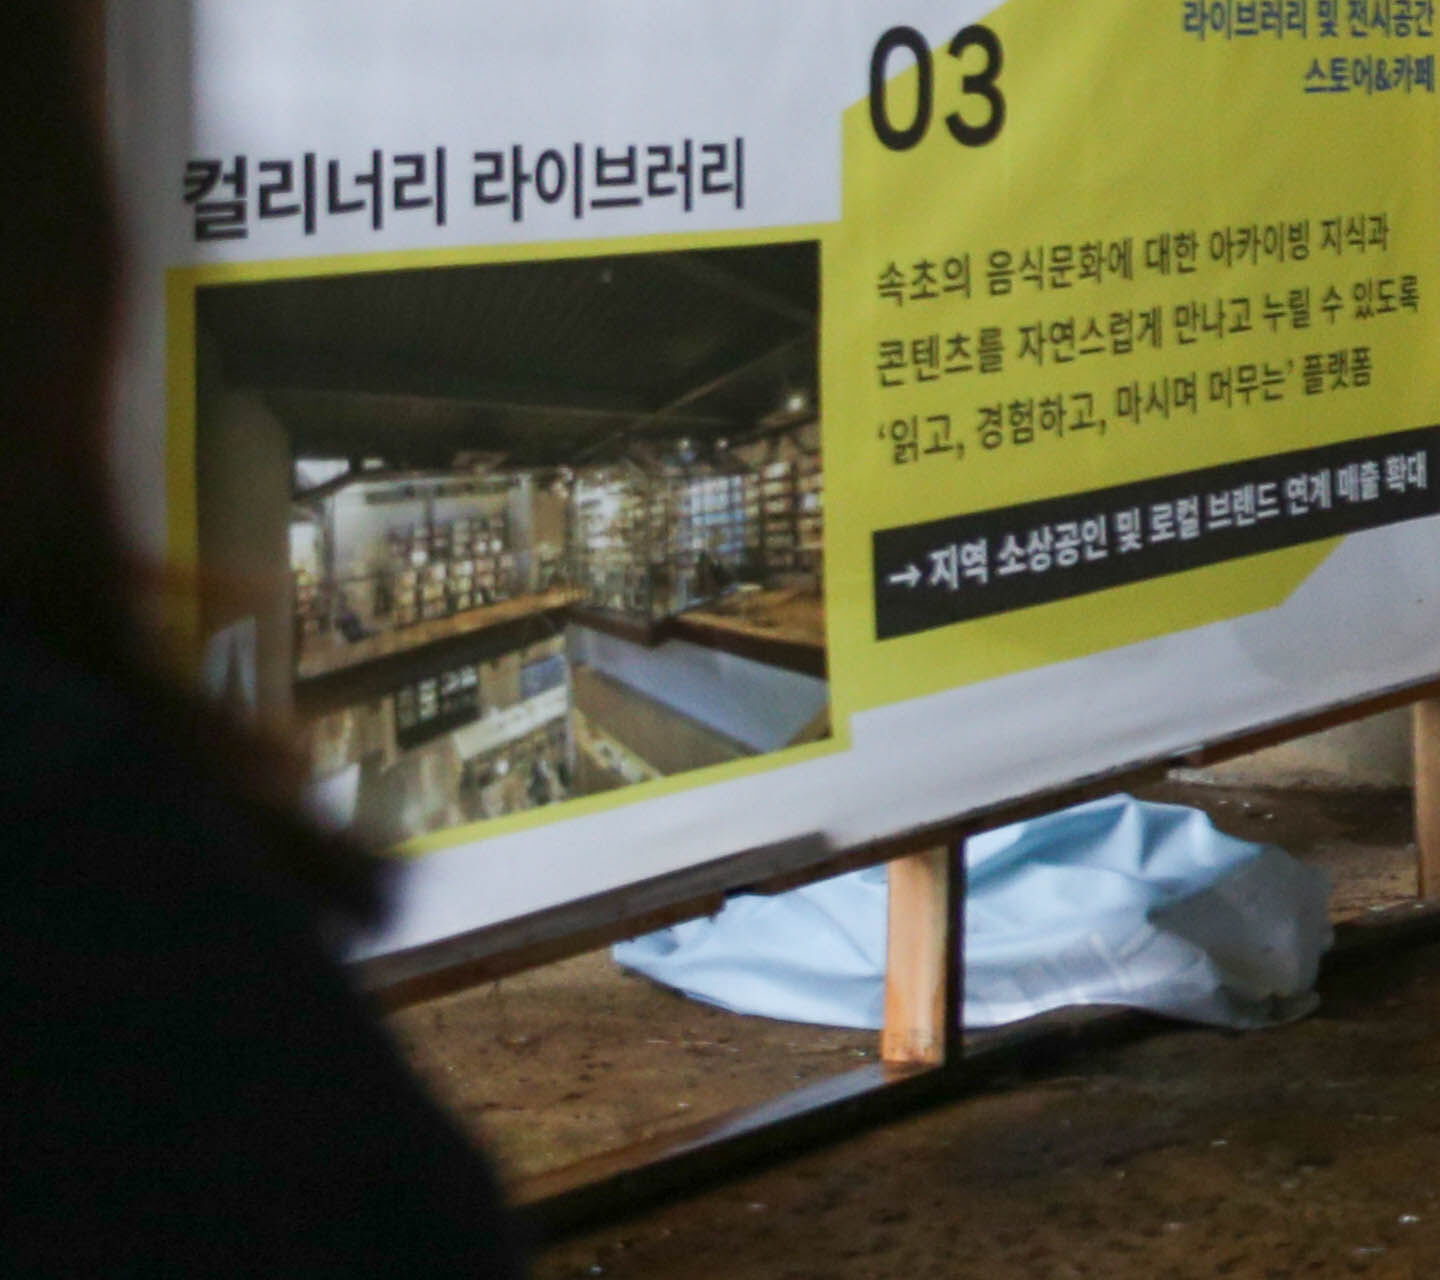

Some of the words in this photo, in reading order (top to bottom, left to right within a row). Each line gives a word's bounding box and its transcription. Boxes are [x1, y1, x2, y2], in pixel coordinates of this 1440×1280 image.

[868, 24, 1007, 151] 03
[1303, 54, 1435, 96] 스토어&카페
[183, 145, 446, 242] 컬리너리
[472, 137, 743, 222] 라이브러리
[877, 252, 971, 307] 속초의
[986, 237, 1133, 296] 음식문화에
[1145, 229, 1199, 275] 대한
[1210, 219, 1310, 267] 아카이빙
[1321, 212, 1391, 256] 지식과
[877, 327, 1005, 388] 콘텐츠를
[1018, 306, 1162, 366] 자연스럽게
[1174, 297, 1252, 345] 만나고
[1262, 286, 1310, 334] 누릴
[1322, 285, 1343, 324] 수
[1353, 275, 1420, 320] 있도록
[977, 392, 1106, 451] 경험하고,
[1116, 372, 1197, 424] 마시며
[1302, 347, 1373, 396] 플랫폼
[928, 537, 988, 591] 지역
[997, 515, 1107, 576] 소상공인
[1114, 508, 1143, 552] 및
[1150, 497, 1200, 541] 로컬
[1208, 483, 1280, 530] 브랜드
[1285, 470, 1331, 514] 연계
[1337, 461, 1380, 503] 매출
[1385, 451, 1429, 494] 확대
